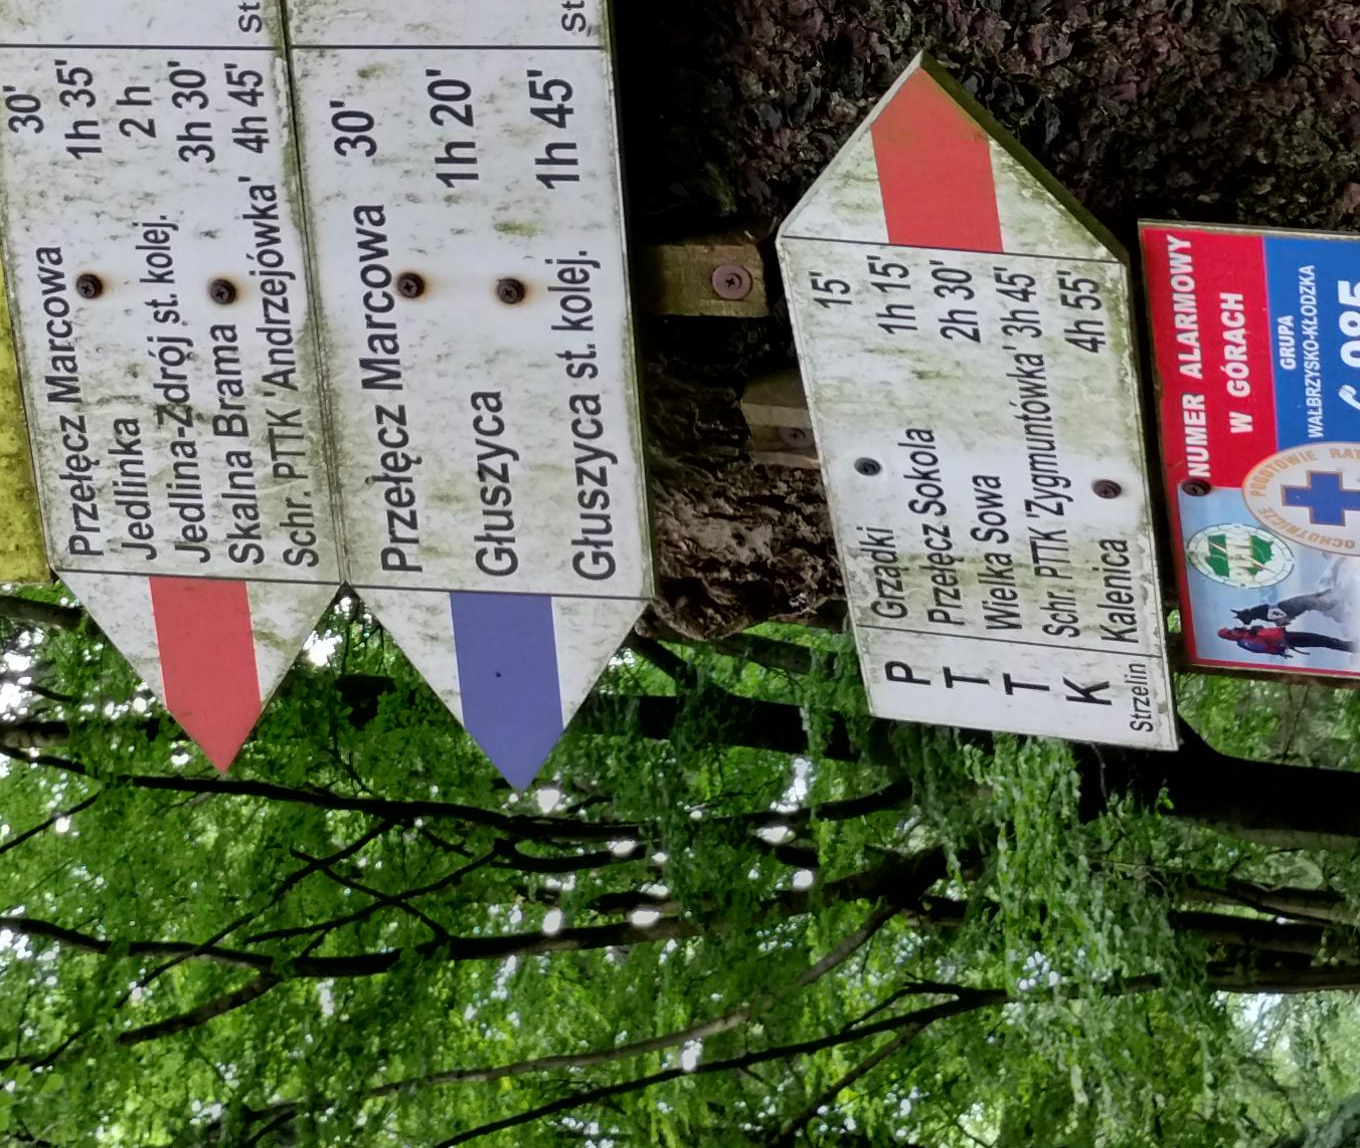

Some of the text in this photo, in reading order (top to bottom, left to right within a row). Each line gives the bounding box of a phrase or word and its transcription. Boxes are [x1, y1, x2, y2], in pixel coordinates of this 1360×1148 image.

[3, 85, 104, 556] Przełęcz Marcowa 30'
[55, 59, 158, 560] Jedlinka 1h 35'
[116, 86, 211, 564] Jedlina-Zdrój st. kolej. 2 h
[167, 60, 265, 565] Skalna Brama 3h 30'
[224, 63, 320, 568] Schr. PTTK 'Andrzejówka' 4h 45'
[330, 100, 423, 573] Przełęcz Marcowa 30'
[426, 69, 520, 577] Głuszyca 1h 20'
[527, 69, 618, 581] Głuszyca st. kolej. 1h 45'
[809, 271, 909, 619] Grządki 15'
[866, 254, 965, 626] Przełęcz Sokola 1h 15'
[929, 260, 1022, 630] Wielka Sowa 2h 30'
[993, 267, 1081, 638] Schr. PTTK 'Zygmuntówka' 3h 45'
[1056, 270, 1139, 644] Kalenica 4h 55'
[1166, 235, 1211, 478] NUMER ALARMOWY
[1220, 292, 1253, 434] W GÓRACH
[1277, 315, 1296, 370] GRUPA
[1299, 265, 1324, 438] WAŁBRZYSKO-KŁODZKA
[1125, 663, 1154, 732] Strzelin
